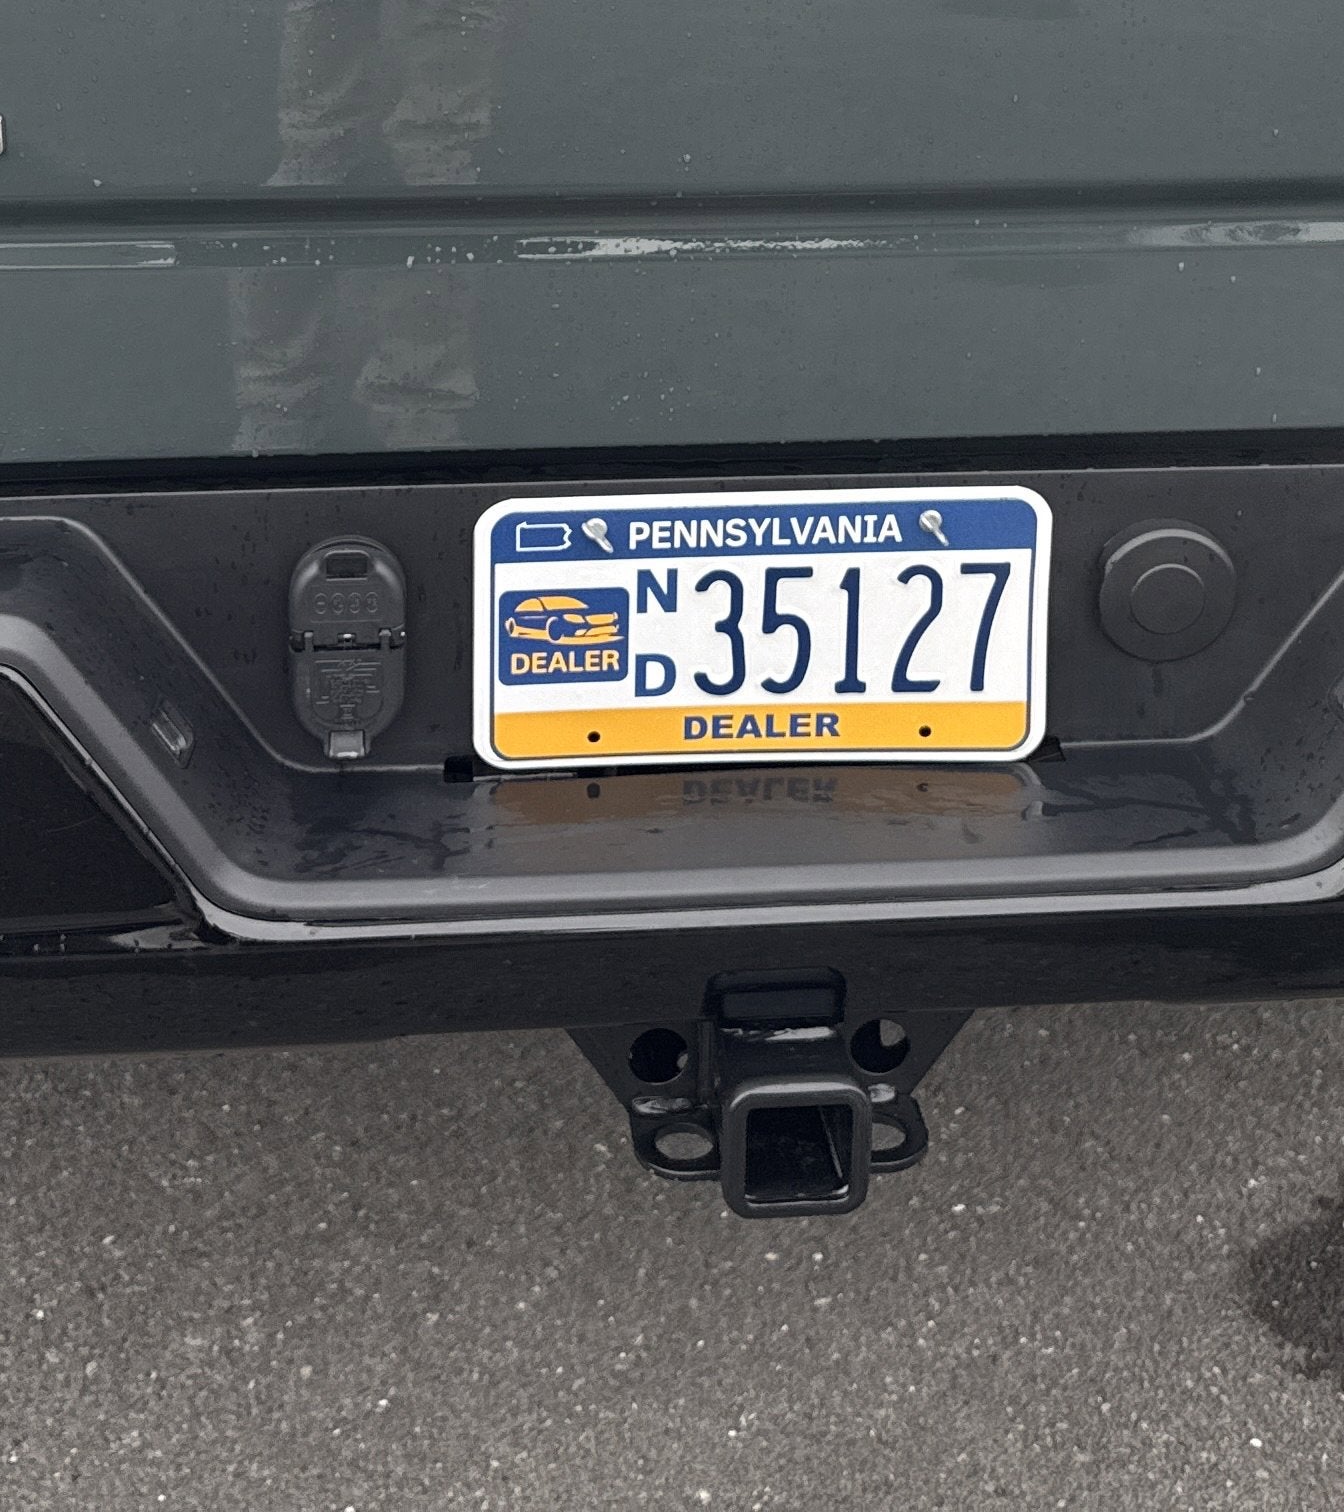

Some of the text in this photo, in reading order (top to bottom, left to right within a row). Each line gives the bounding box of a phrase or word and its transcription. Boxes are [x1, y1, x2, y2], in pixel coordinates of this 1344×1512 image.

[628, 514, 903, 550] PENNSYLVANIA
[693, 562, 1012, 696] 35127
[510, 650, 621, 676] DEALER
[683, 713, 841, 741] DEALER
